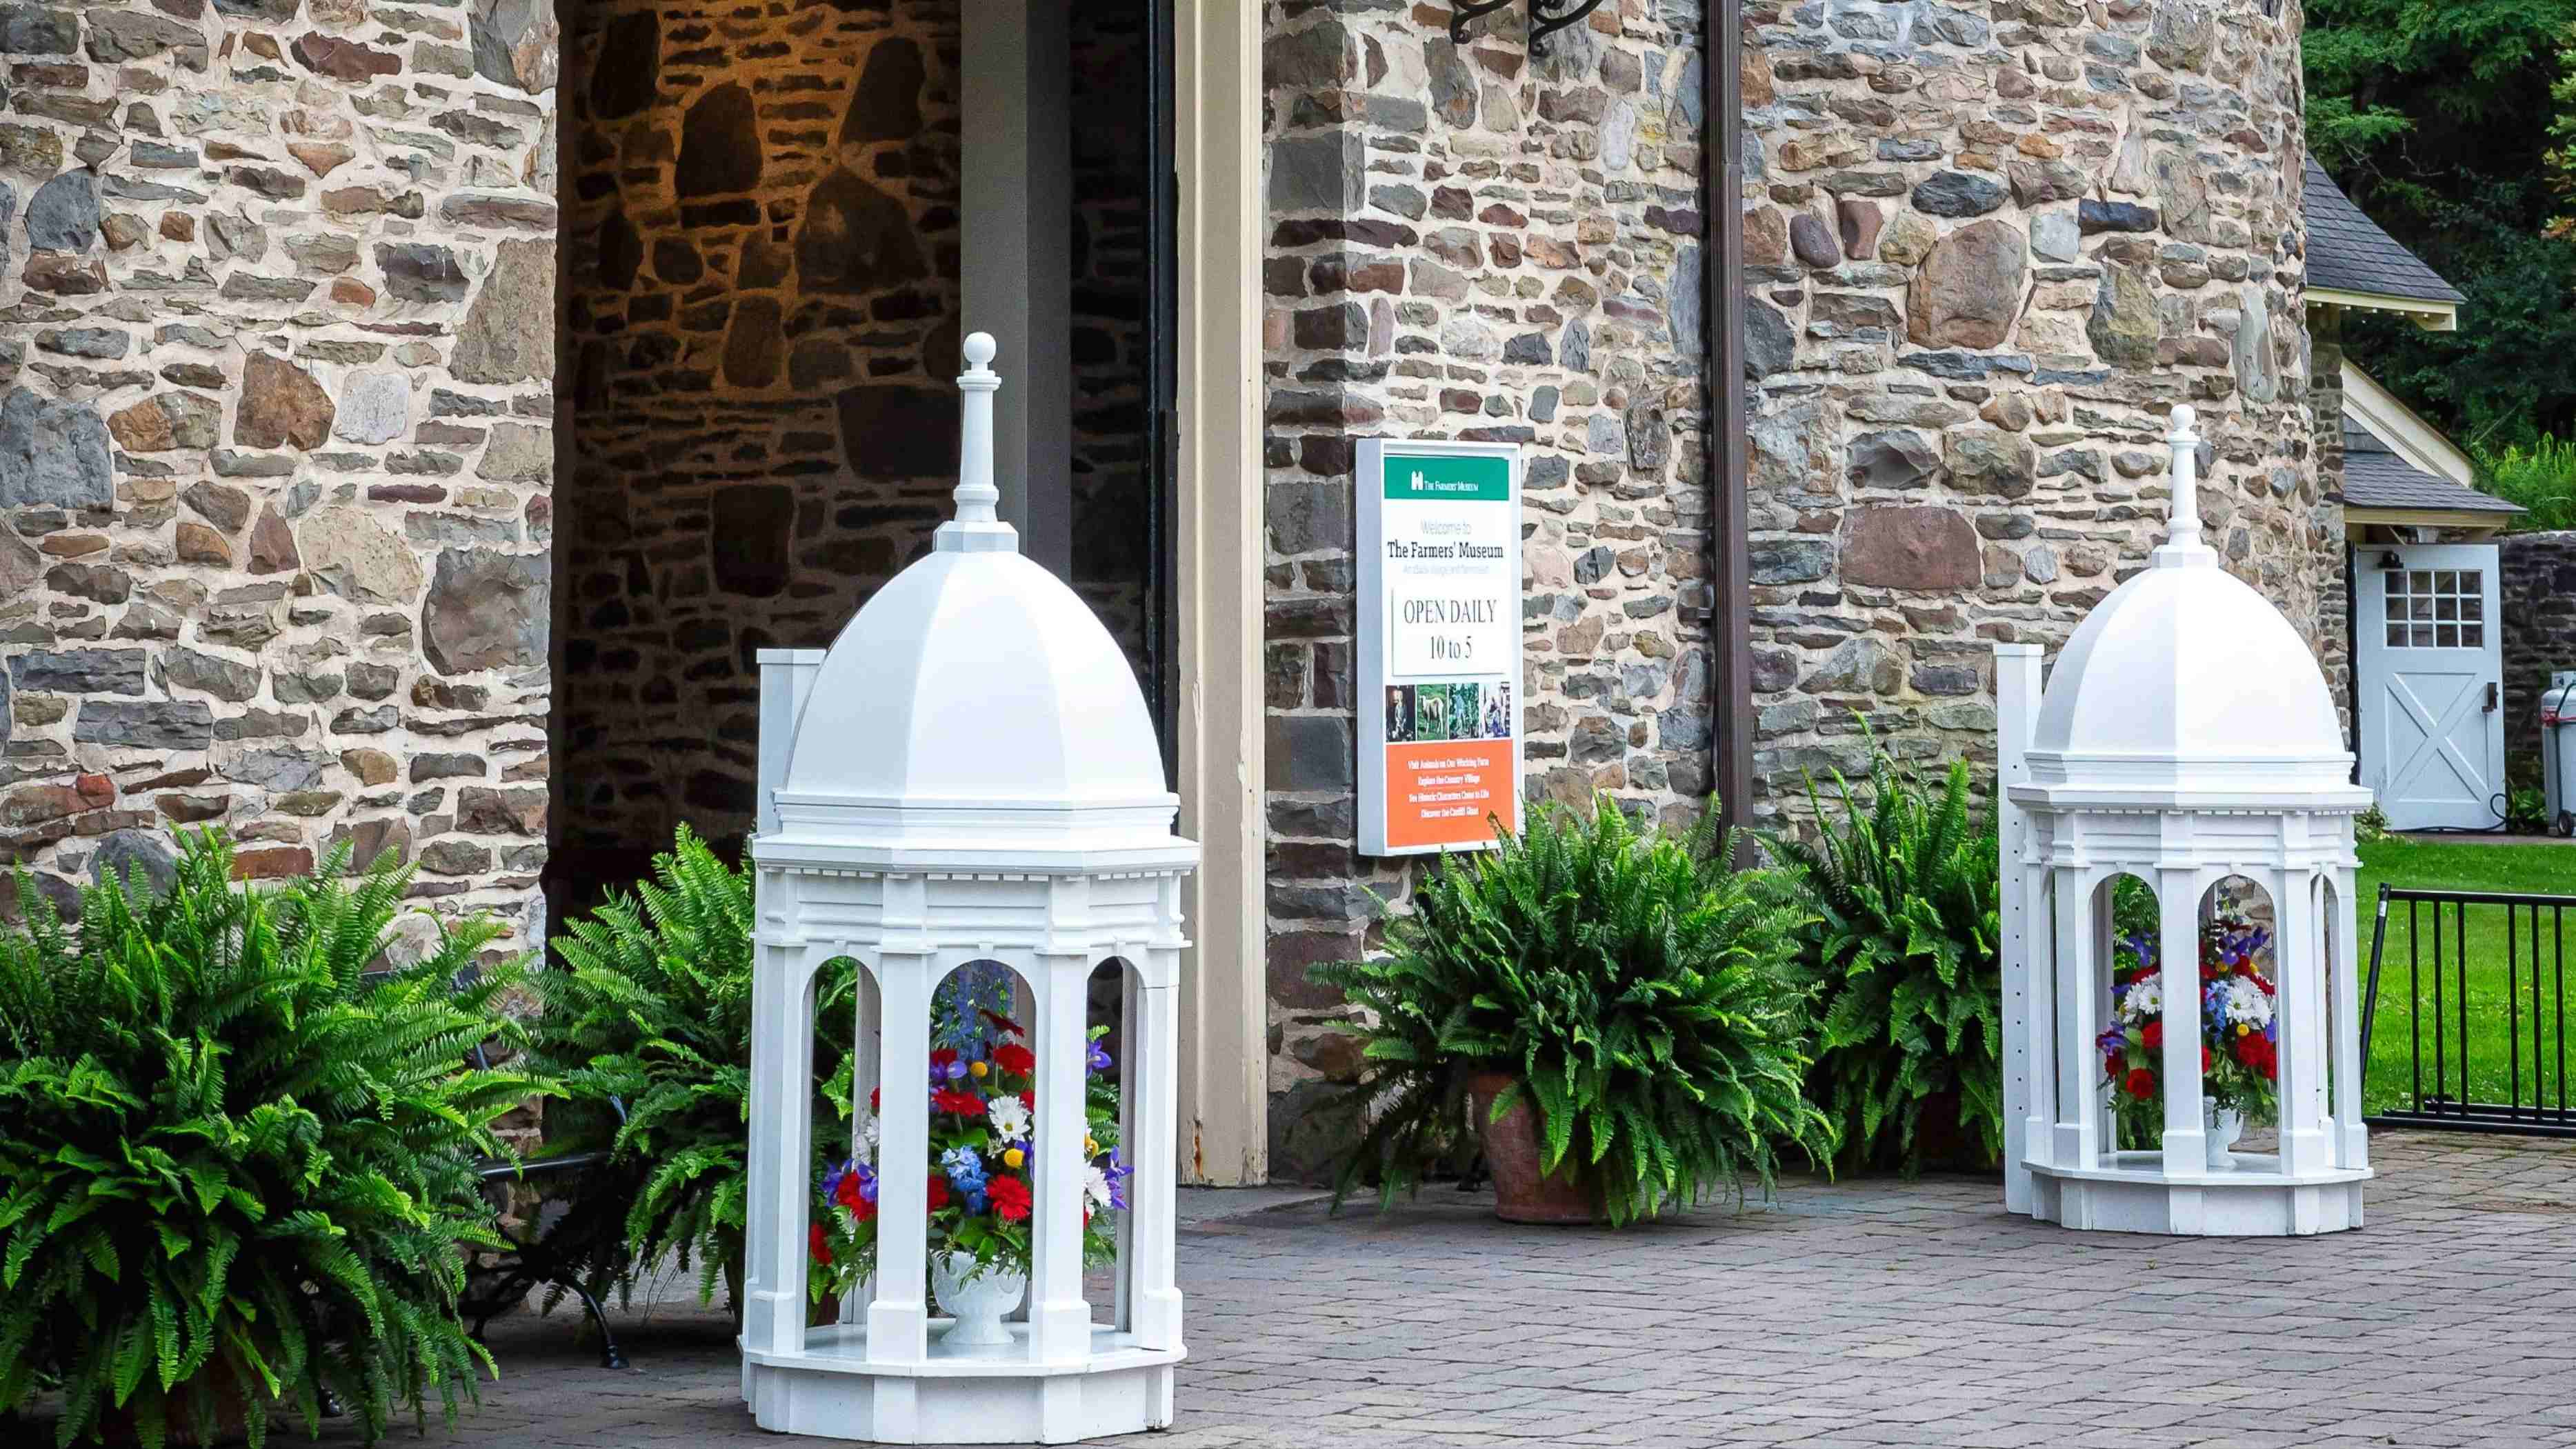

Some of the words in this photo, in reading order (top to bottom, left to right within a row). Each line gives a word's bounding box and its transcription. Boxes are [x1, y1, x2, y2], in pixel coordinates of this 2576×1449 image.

[1420, 519, 1461, 535] Welcome
[1463, 519, 1472, 535] to
[1387, 539, 1408, 558] The
[1411, 541, 1456, 558] Farmers'
[1459, 541, 1504, 558] Museum
[1404, 599, 1445, 623] OPEN
[1450, 599, 1497, 623] DAILY
[1430, 635, 1445, 659] 10
[1449, 639, 1461, 659] to
[1465, 635, 1472, 659] 5
